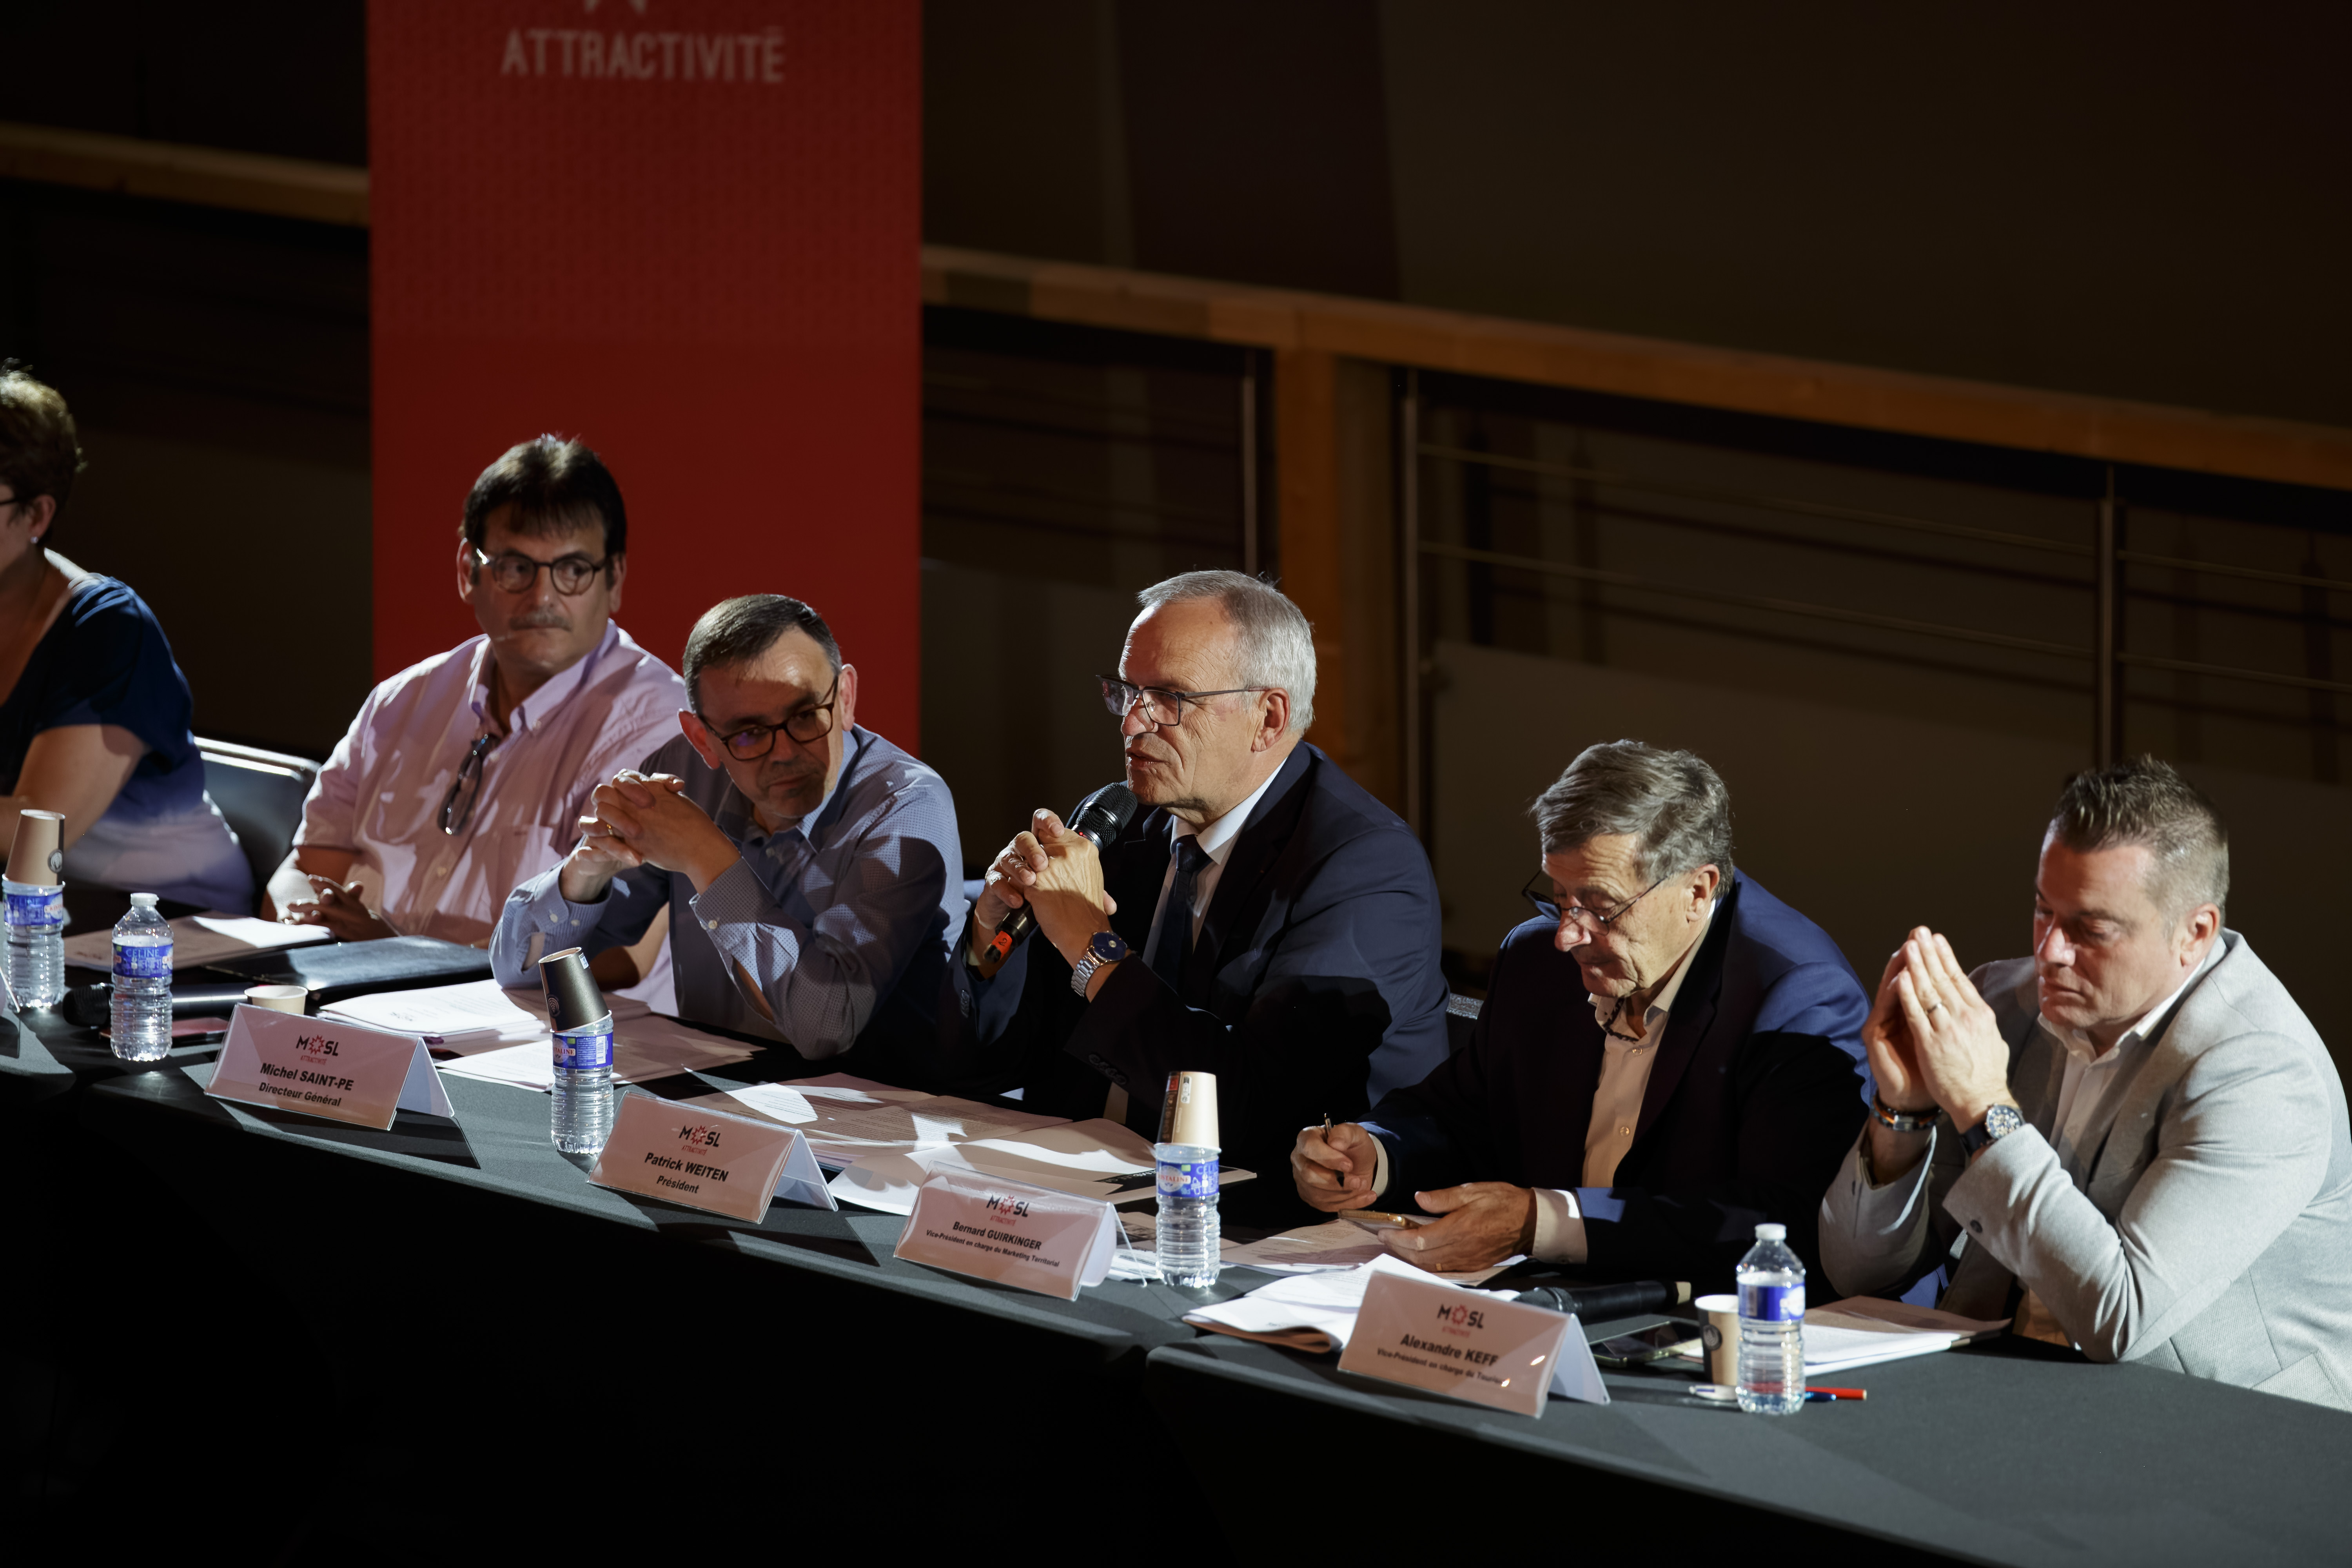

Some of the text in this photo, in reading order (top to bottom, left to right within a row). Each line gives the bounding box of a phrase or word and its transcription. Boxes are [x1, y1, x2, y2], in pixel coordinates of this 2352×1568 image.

[499, 25, 785, 83] ATTRACTIVITÉ
[126, 949, 159, 957] CELINE
[260, 1062, 354, 1091] Michel SAINT-PE
[259, 1082, 342, 1107] Directeur Général
[644, 1152, 729, 1182] Patrick WEITEN
[657, 1175, 699, 1194] Président
[926, 1229, 965, 1245] Vice-Président
[974, 1241, 993, 1252] charge
[1002, 1248, 1030, 1261] Marketing
[1032, 1254, 1060, 1267] Territorial
[953, 1221, 1042, 1250] Bernard GUIRKINGER
[1400, 1334, 1499, 1366] Alexandre KEFF
